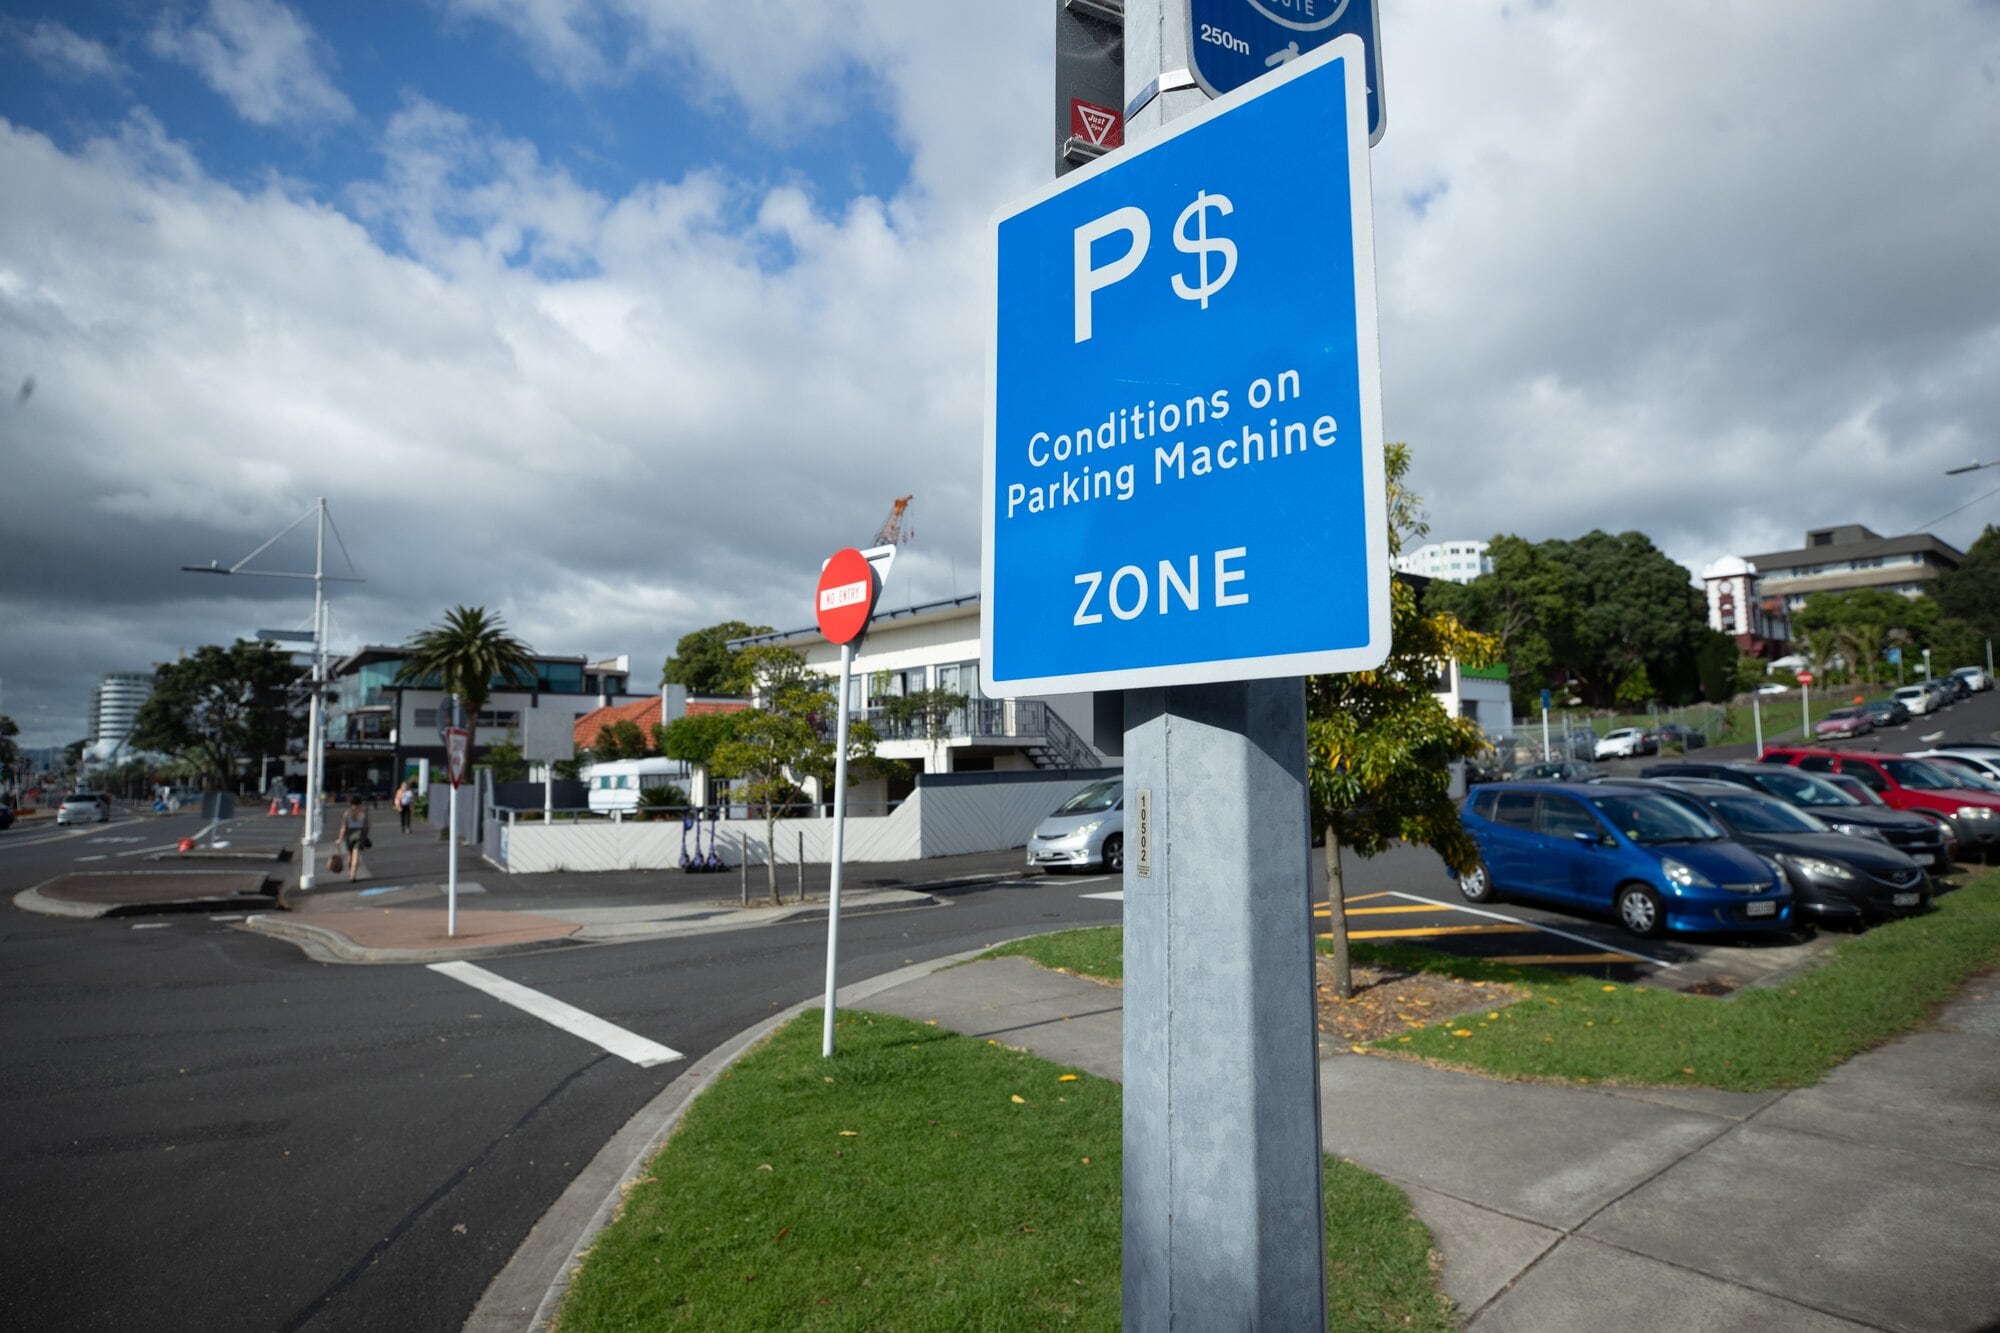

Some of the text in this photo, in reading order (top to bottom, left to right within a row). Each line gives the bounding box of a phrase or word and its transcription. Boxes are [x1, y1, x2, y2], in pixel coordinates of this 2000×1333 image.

[1200, 24, 1250, 56] 250m
[1074, 189, 1238, 344] P $
[1008, 415, 1338, 518] Parking Machine
[1028, 369, 1300, 467] Conditions on
[1073, 546, 1249, 626] ZONE
